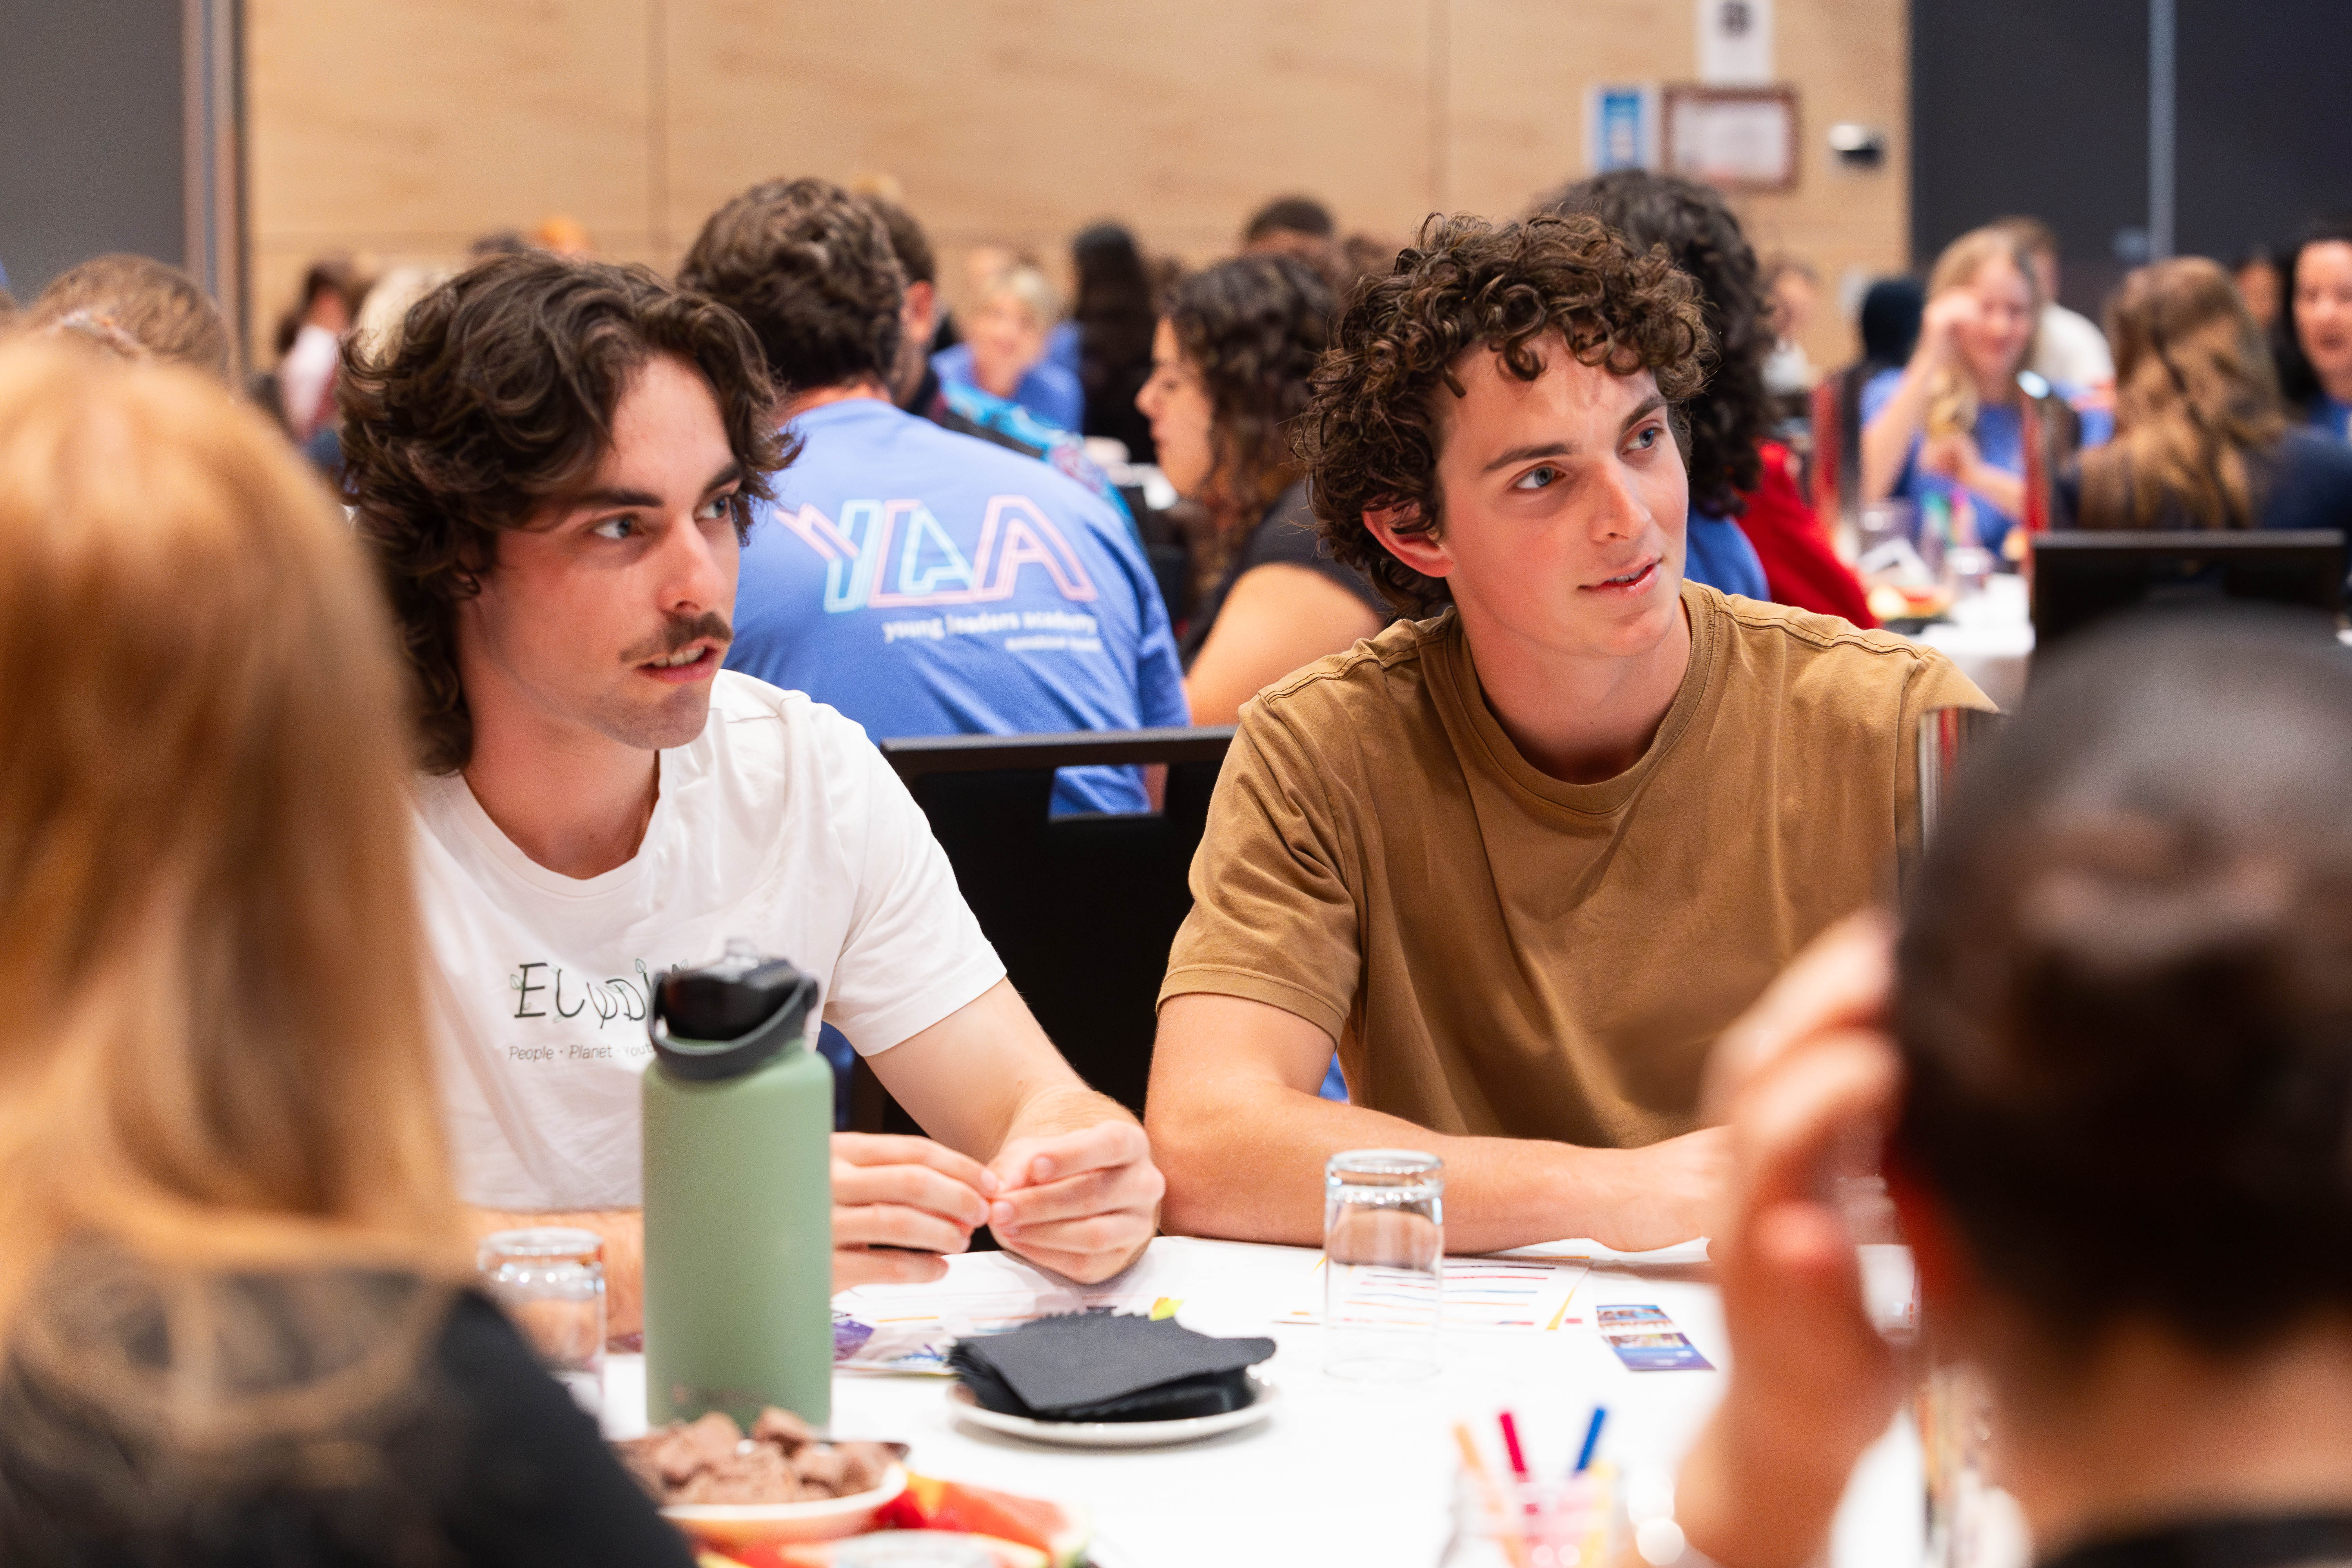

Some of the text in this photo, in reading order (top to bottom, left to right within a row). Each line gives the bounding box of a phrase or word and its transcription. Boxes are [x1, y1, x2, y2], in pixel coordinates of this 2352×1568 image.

[509, 1043, 655, 1062] People Planet Yout
